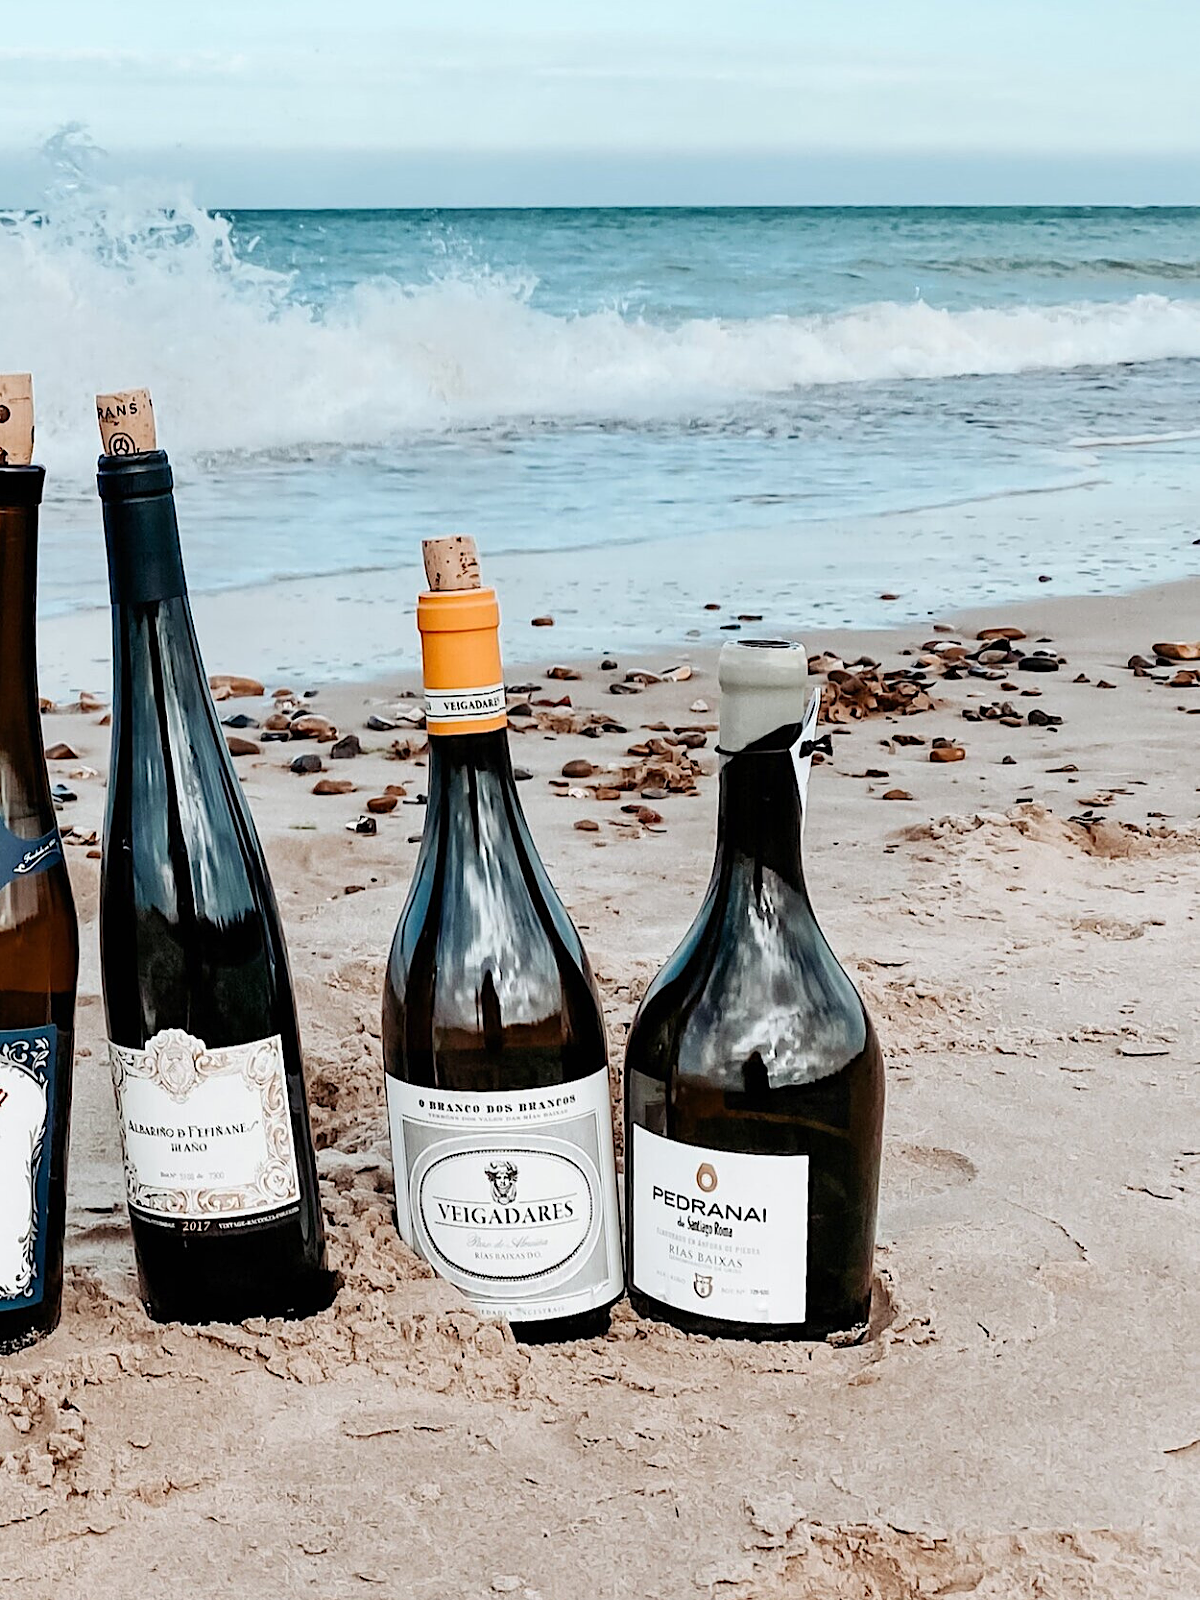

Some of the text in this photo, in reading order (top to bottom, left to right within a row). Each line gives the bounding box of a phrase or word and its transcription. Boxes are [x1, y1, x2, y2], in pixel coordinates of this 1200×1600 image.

[444, 697, 500, 711] VEIGADARES
[418, 1095, 576, 1114] O BRANCO DOS BRANCOS
[184, 1142, 208, 1152] AÑO
[653, 1185, 767, 1223] PEDRANAI
[437, 1201, 575, 1225] VEIGADARES
[182, 1221, 211, 1231] 2017
[714, 1221, 733, 1237] Roma
[475, 1252, 493, 1260] RÍAS
[495, 1252, 525, 1260] BAIXAS
[669, 1244, 743, 1268] RÍAS BAIXAS
